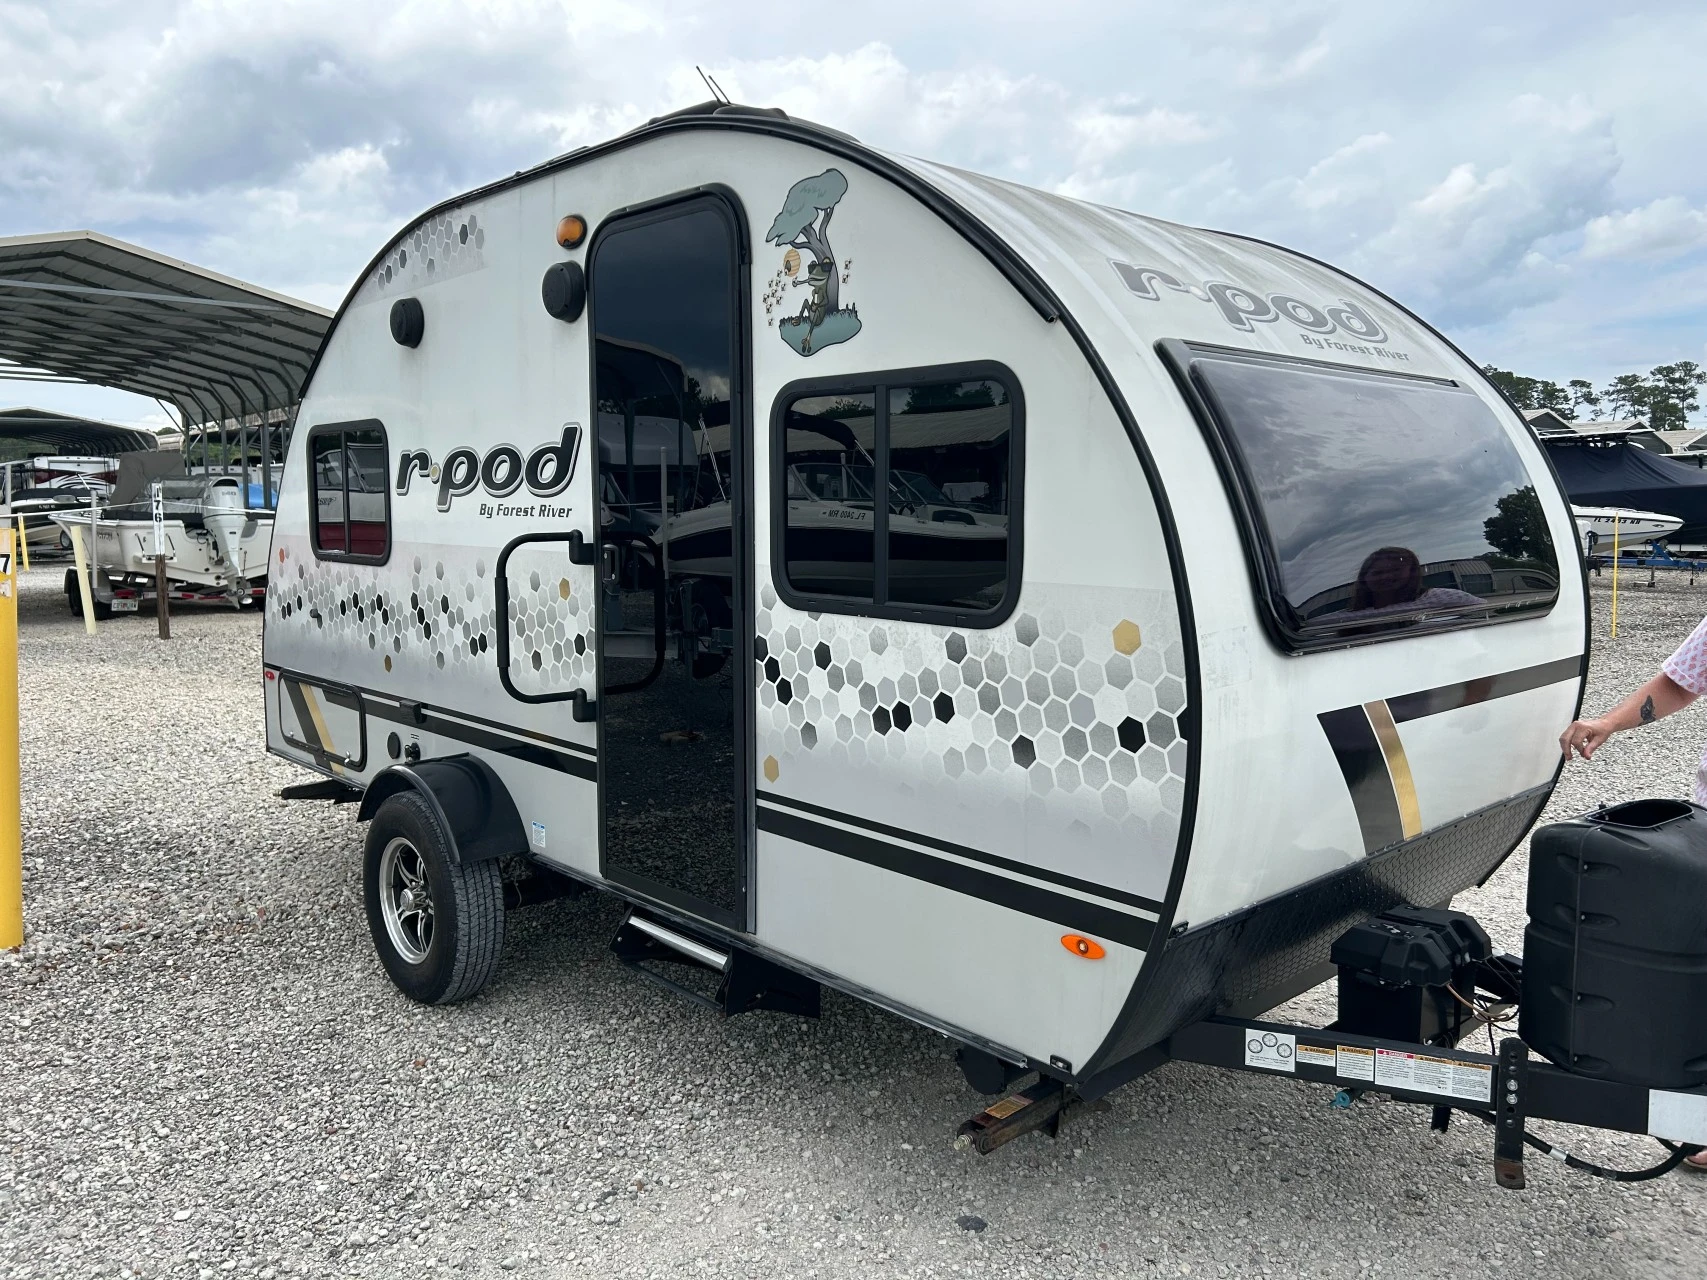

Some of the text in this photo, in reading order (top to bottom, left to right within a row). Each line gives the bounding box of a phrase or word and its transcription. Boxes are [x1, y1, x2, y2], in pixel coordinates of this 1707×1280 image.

[1300, 334, 1409, 361] By Forest River
[479, 503, 573, 519] By Forest River
[0, 554, 10, 574] 7
